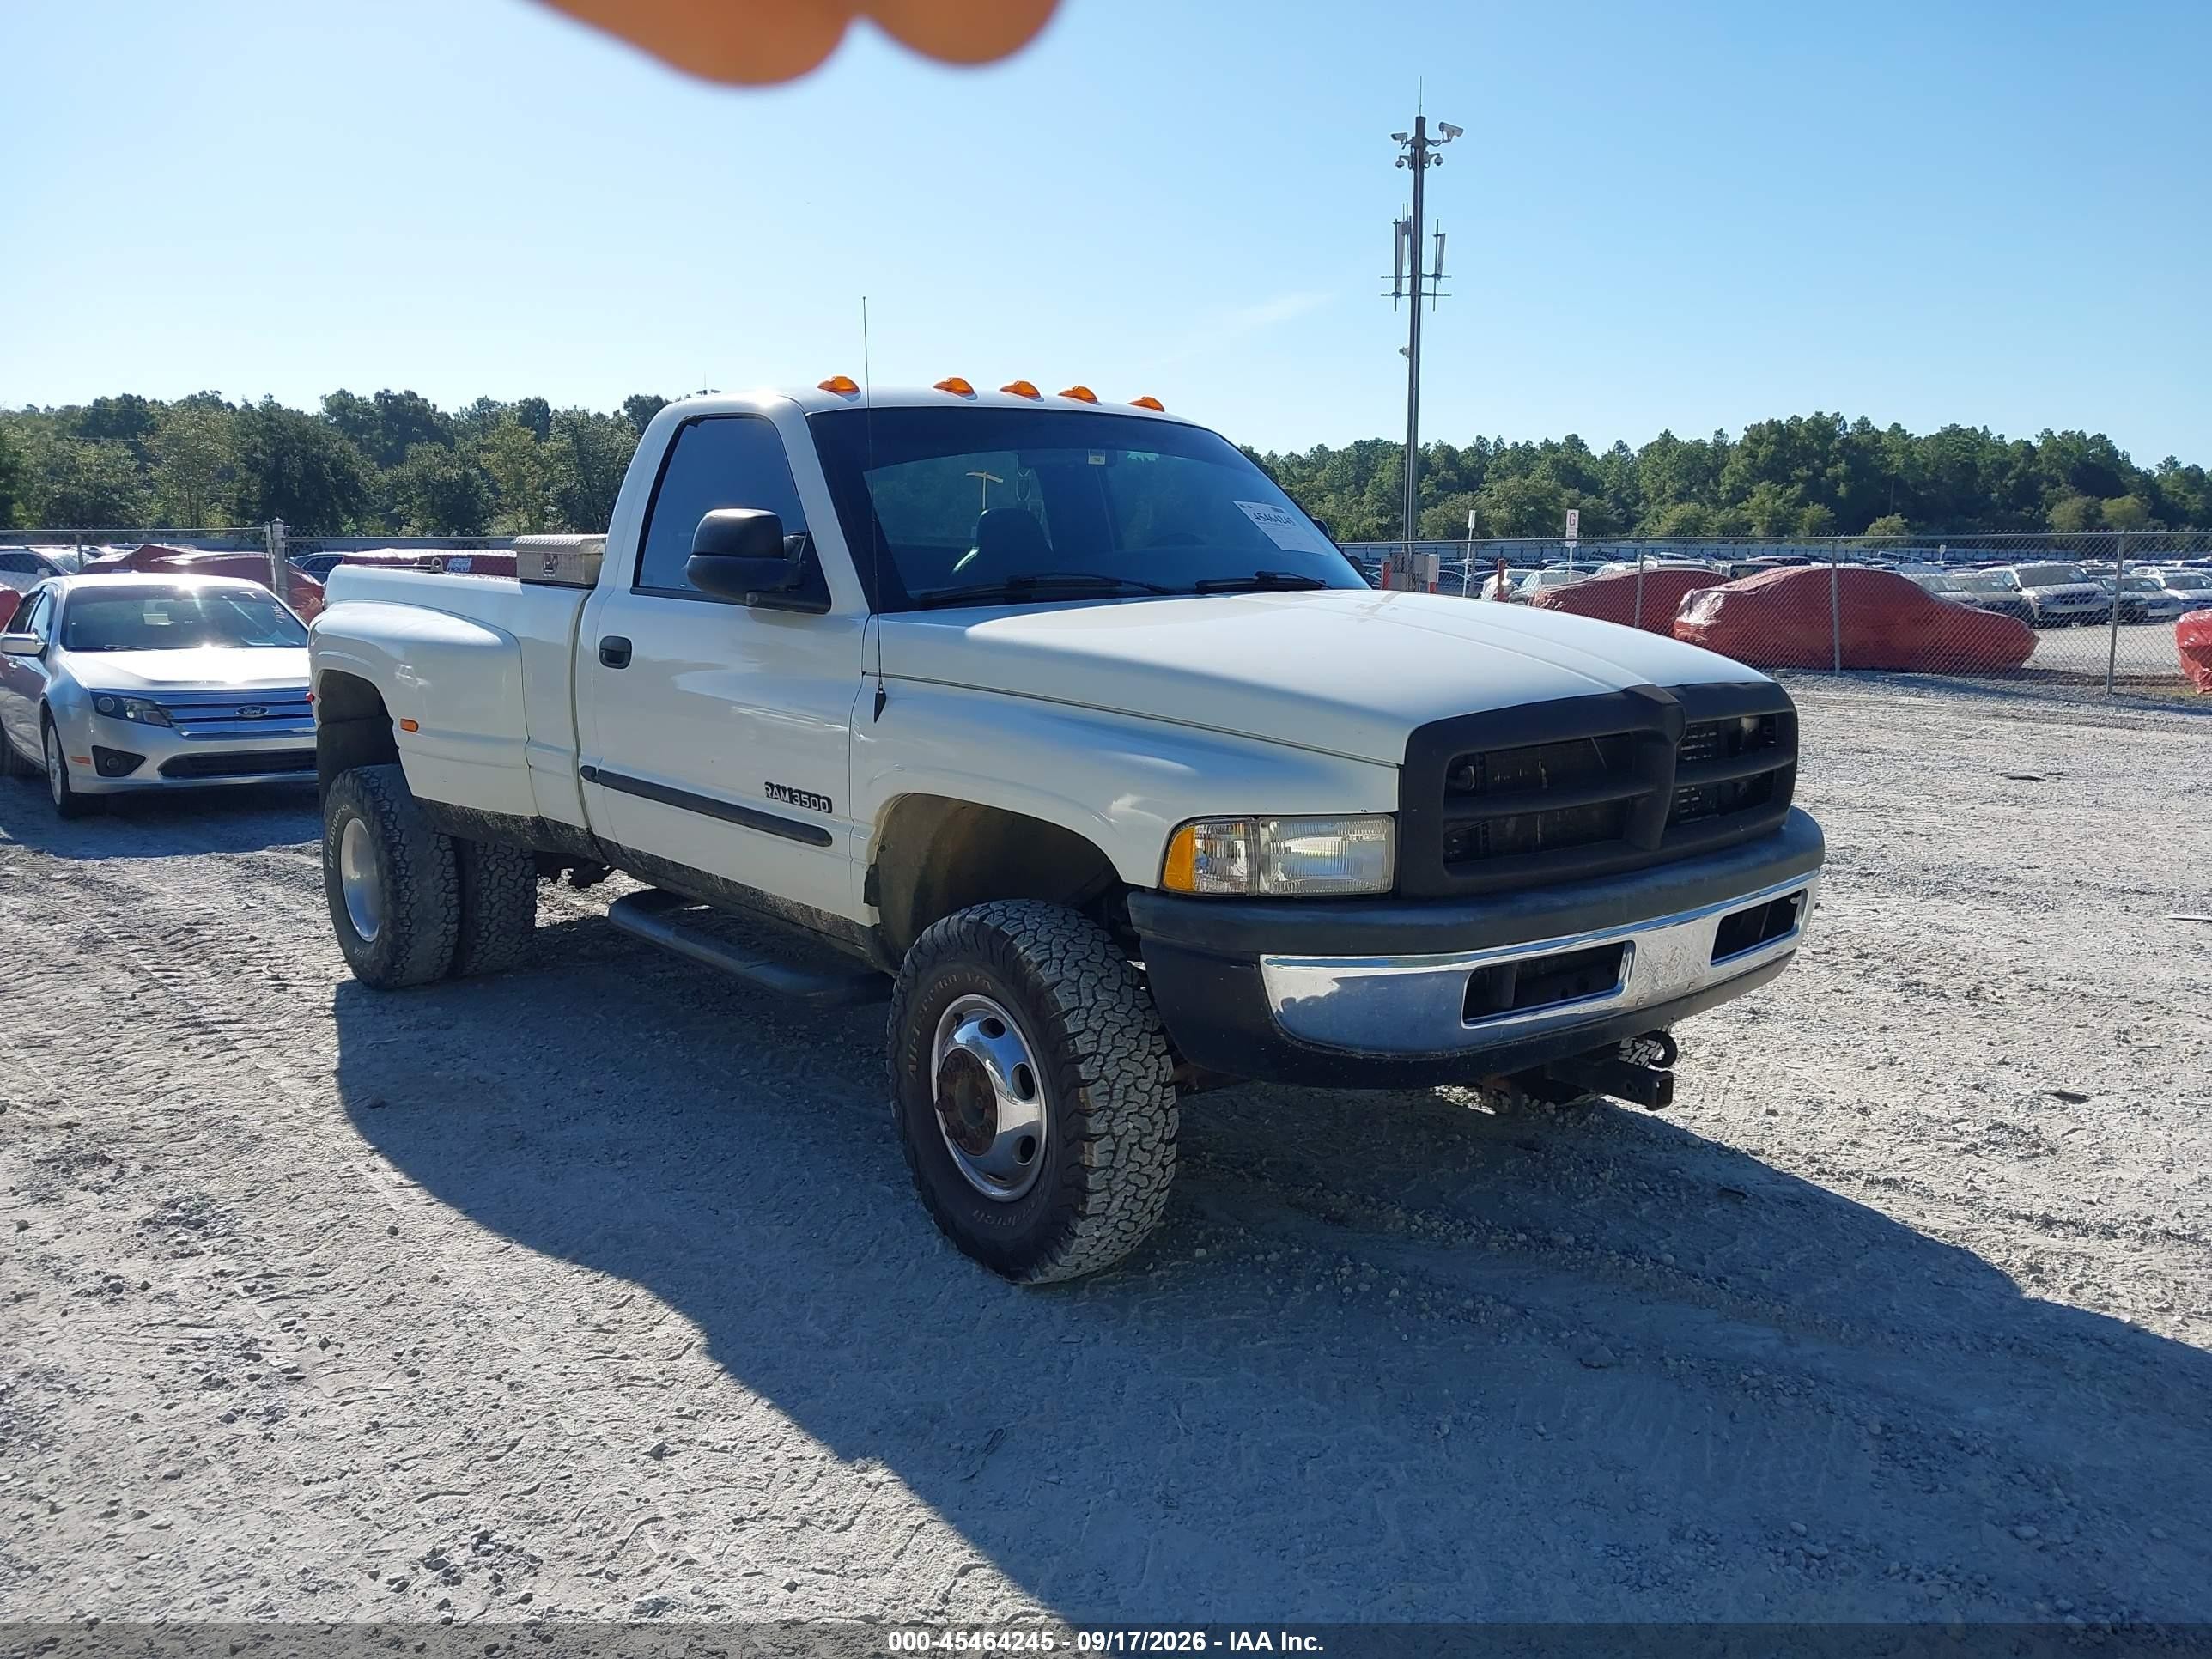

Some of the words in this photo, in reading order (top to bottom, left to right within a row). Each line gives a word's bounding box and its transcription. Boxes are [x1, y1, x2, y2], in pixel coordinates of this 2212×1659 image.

[1569, 512, 1577, 526] G
[763, 781, 793, 805] RAM
[791, 788, 833, 814] 3500
